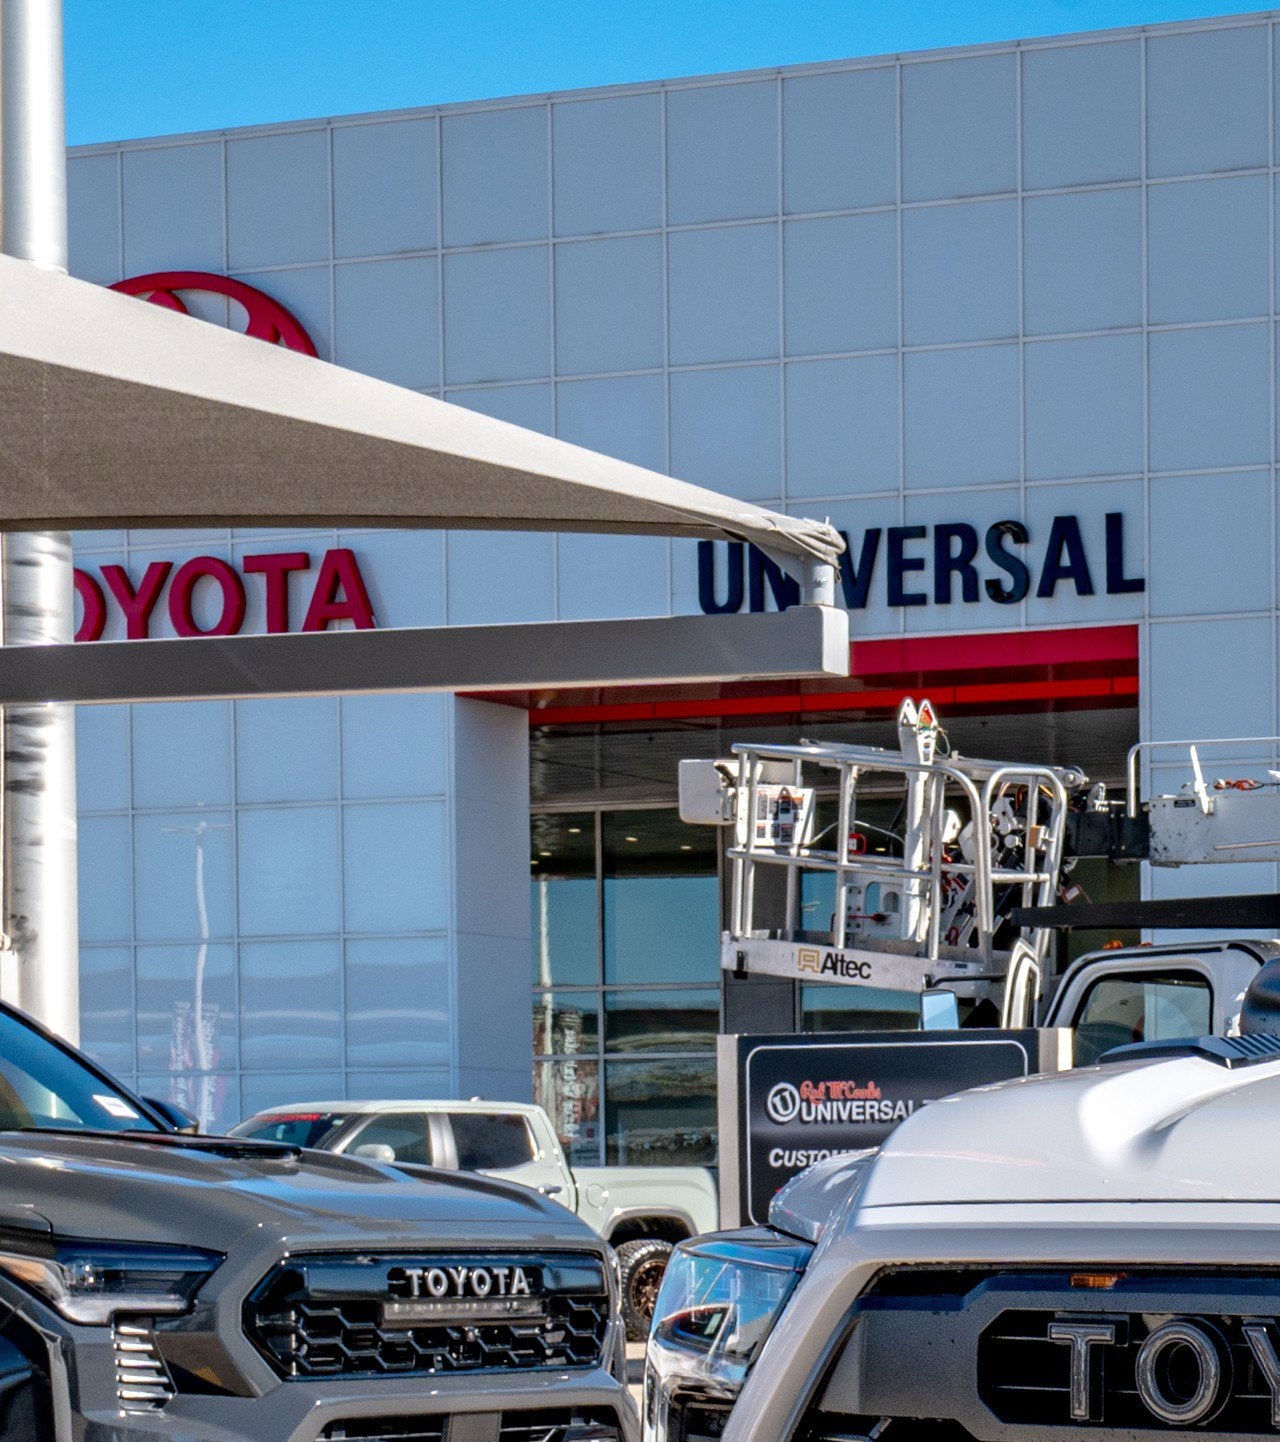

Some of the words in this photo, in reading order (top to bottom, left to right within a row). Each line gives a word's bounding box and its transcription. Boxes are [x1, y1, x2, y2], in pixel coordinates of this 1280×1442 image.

[697, 511, 1146, 615] UNVERSAL
[73, 548, 376, 642] YOTA
[820, 951, 872, 979] Altec
[800, 1080, 825, 1105] Red
[769, 1148, 856, 1168] CUSTO
[405, 1267, 530, 1297] TOYOTA
